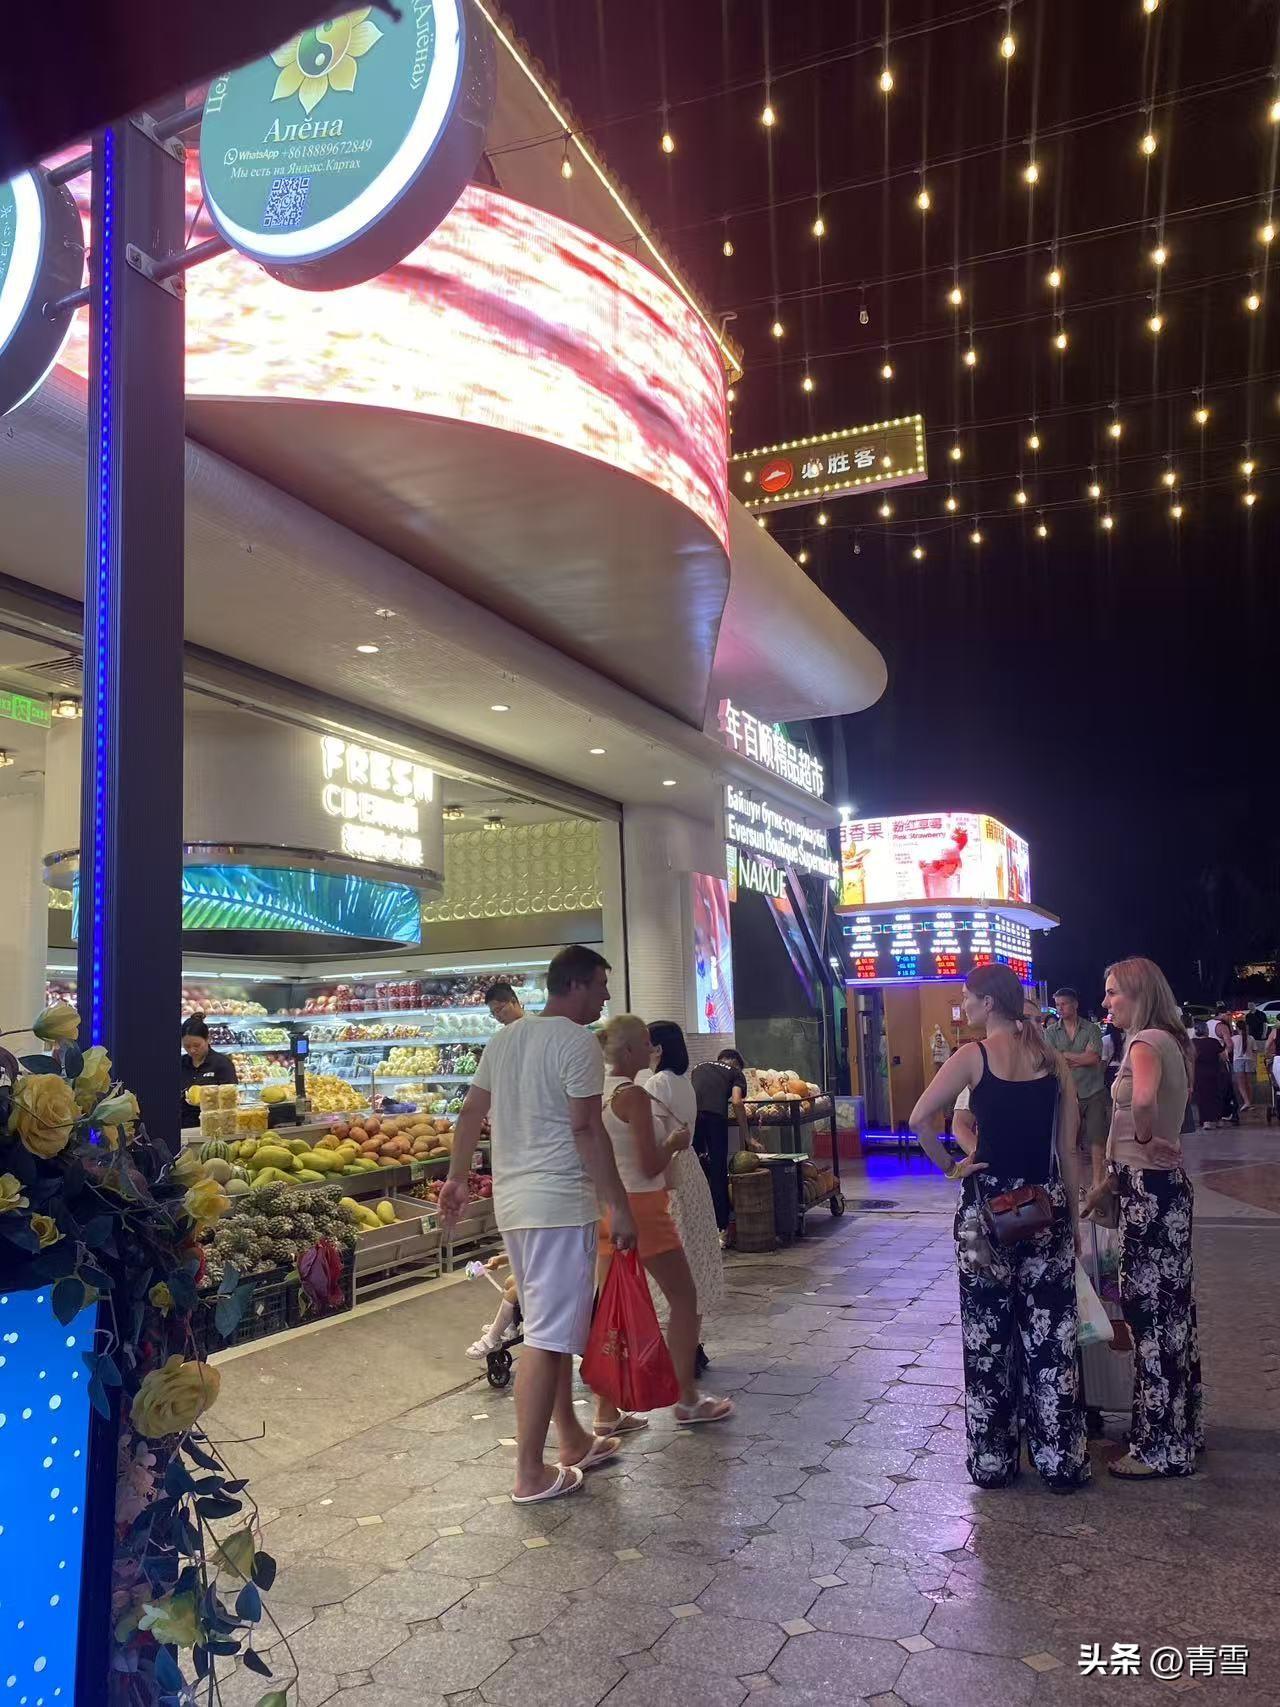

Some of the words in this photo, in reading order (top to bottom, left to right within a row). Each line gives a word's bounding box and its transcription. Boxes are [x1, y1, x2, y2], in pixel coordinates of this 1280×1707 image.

[263, 117, 344, 143] Алёна
[240, 149, 279, 161] WhatsApp
[231, 167, 248, 179] Мы
[251, 167, 271, 177] есть
[274, 167, 285, 175] на
[801, 448, 876, 480] 必胜客
[739, 855, 788, 900] NAIXUE
